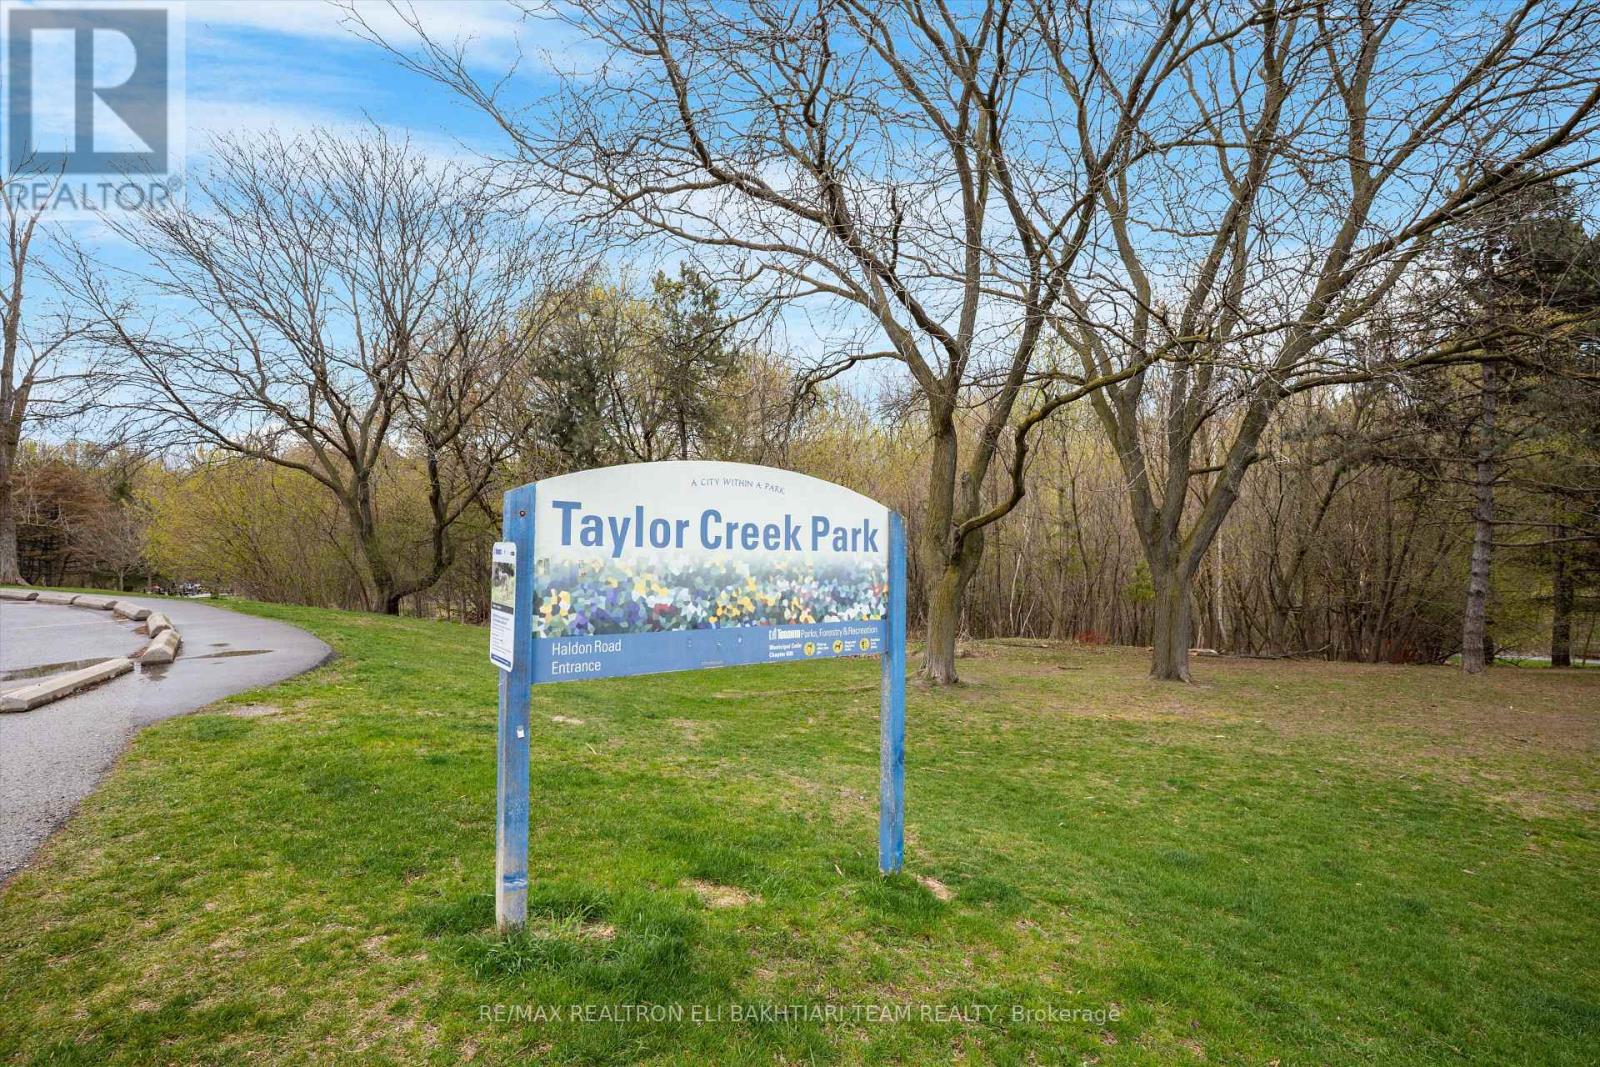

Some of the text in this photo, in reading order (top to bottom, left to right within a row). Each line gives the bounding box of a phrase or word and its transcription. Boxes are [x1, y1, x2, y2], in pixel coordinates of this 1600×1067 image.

[690, 478, 785, 495] A CITY WITHIN A PARK
[552, 500, 879, 558] Taylor Creek Park
[552, 639, 622, 656] Haldon Road
[552, 660, 601, 675] Entrance
